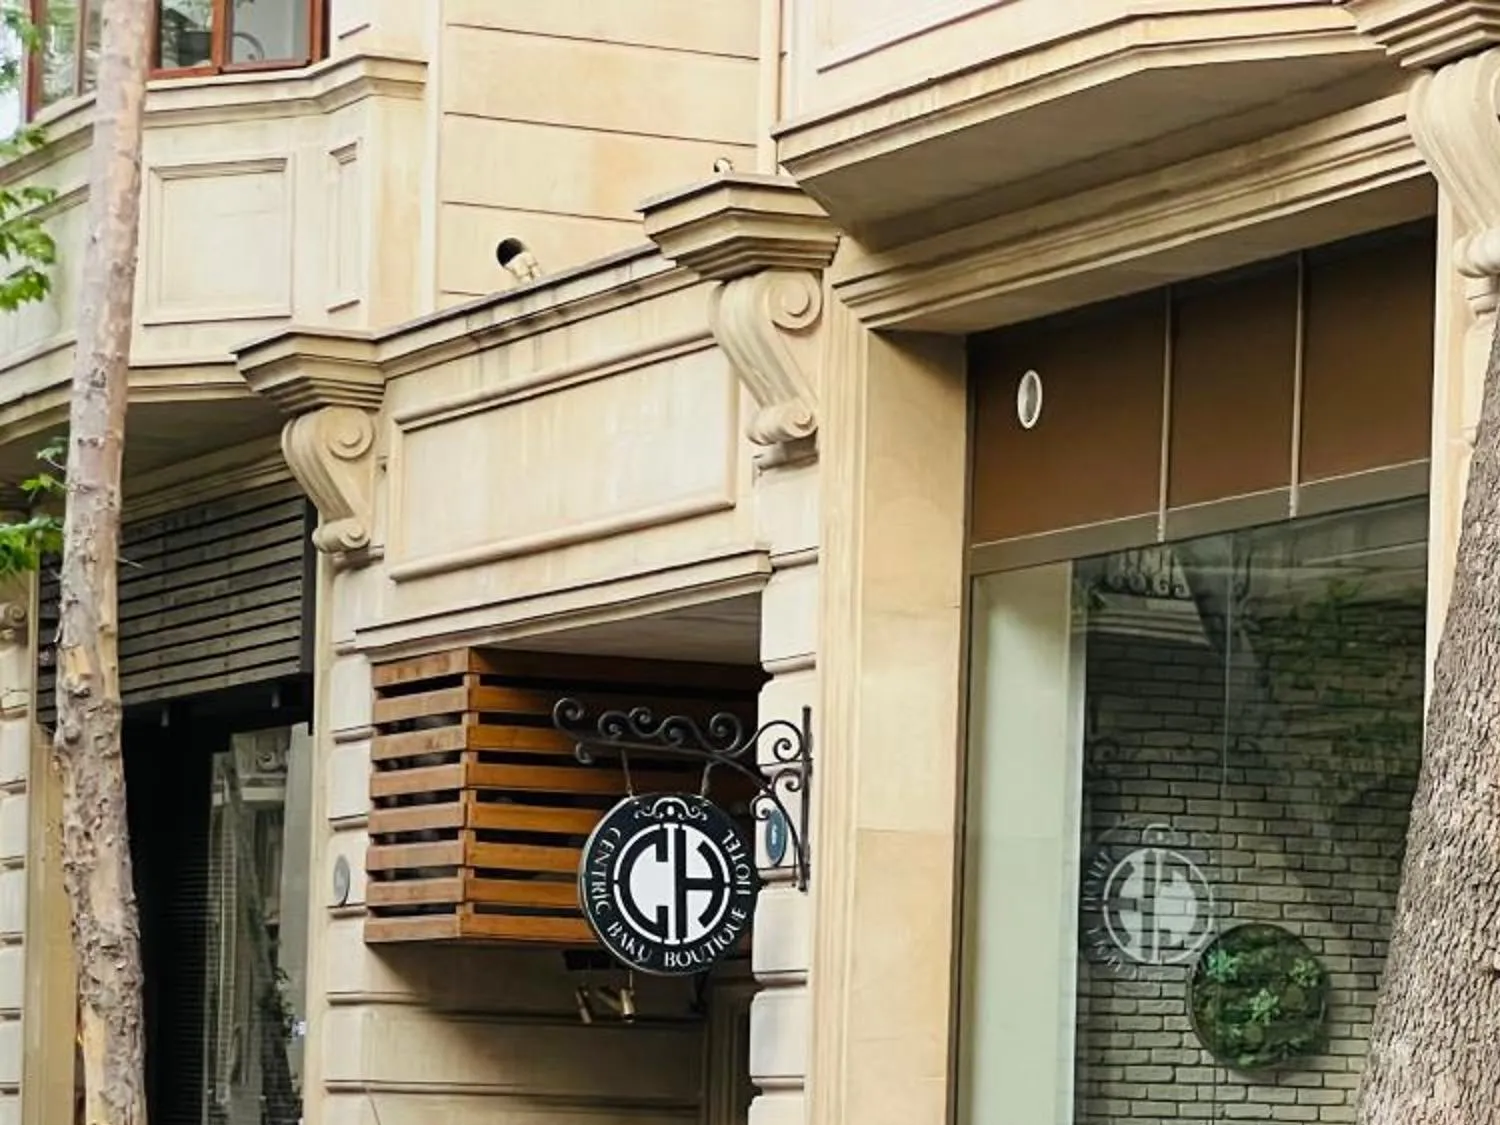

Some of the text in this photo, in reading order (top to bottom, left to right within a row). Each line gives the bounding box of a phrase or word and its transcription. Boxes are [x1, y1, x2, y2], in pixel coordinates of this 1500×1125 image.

[591, 827, 621, 914] CENTRIC
[607, 921, 651, 962] BAKU
[665, 907, 748, 966] BOUTIQUE
[721, 829, 751, 895] HOTEL
